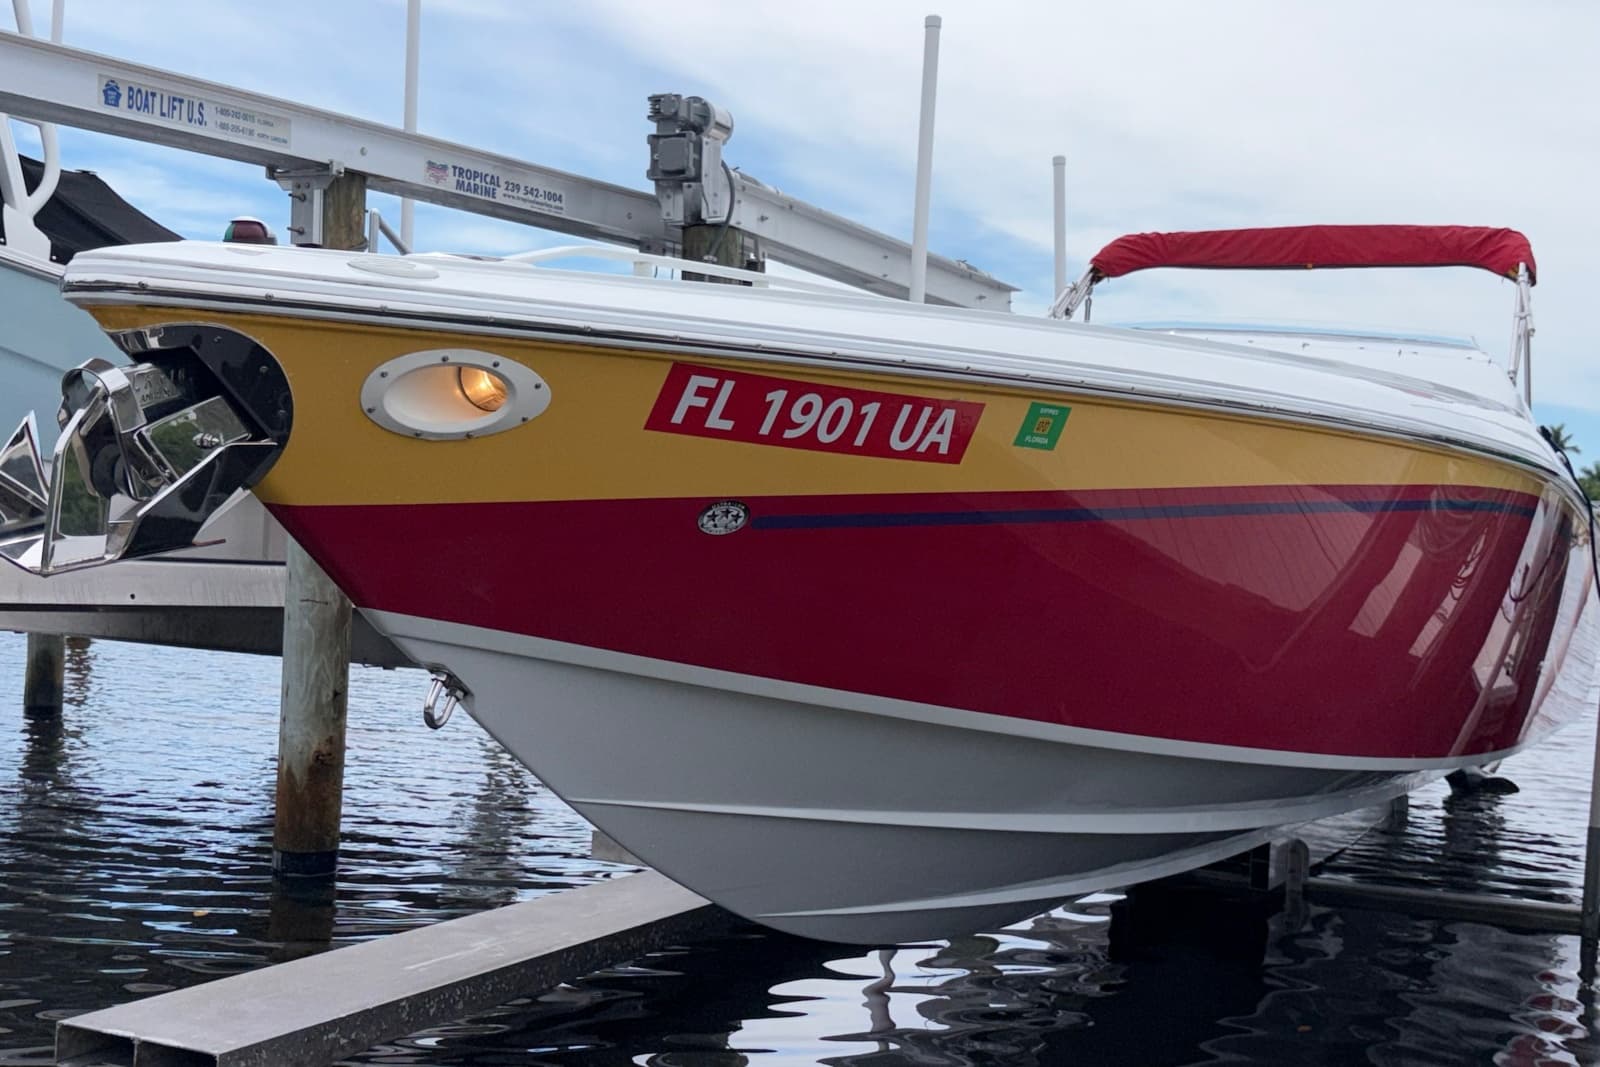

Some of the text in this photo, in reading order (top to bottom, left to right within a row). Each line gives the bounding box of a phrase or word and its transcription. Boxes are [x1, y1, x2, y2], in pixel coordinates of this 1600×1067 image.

[127, 86, 157, 114] BOAT
[159, 93, 185, 121] LIFT
[187, 100, 208, 126] U.S.
[451, 165, 501, 188] TROPICAL
[456, 179, 497, 199] MARINE
[504, 181, 563, 203] 239 542-1004
[670, 374, 957, 455] FL 1901 UA
